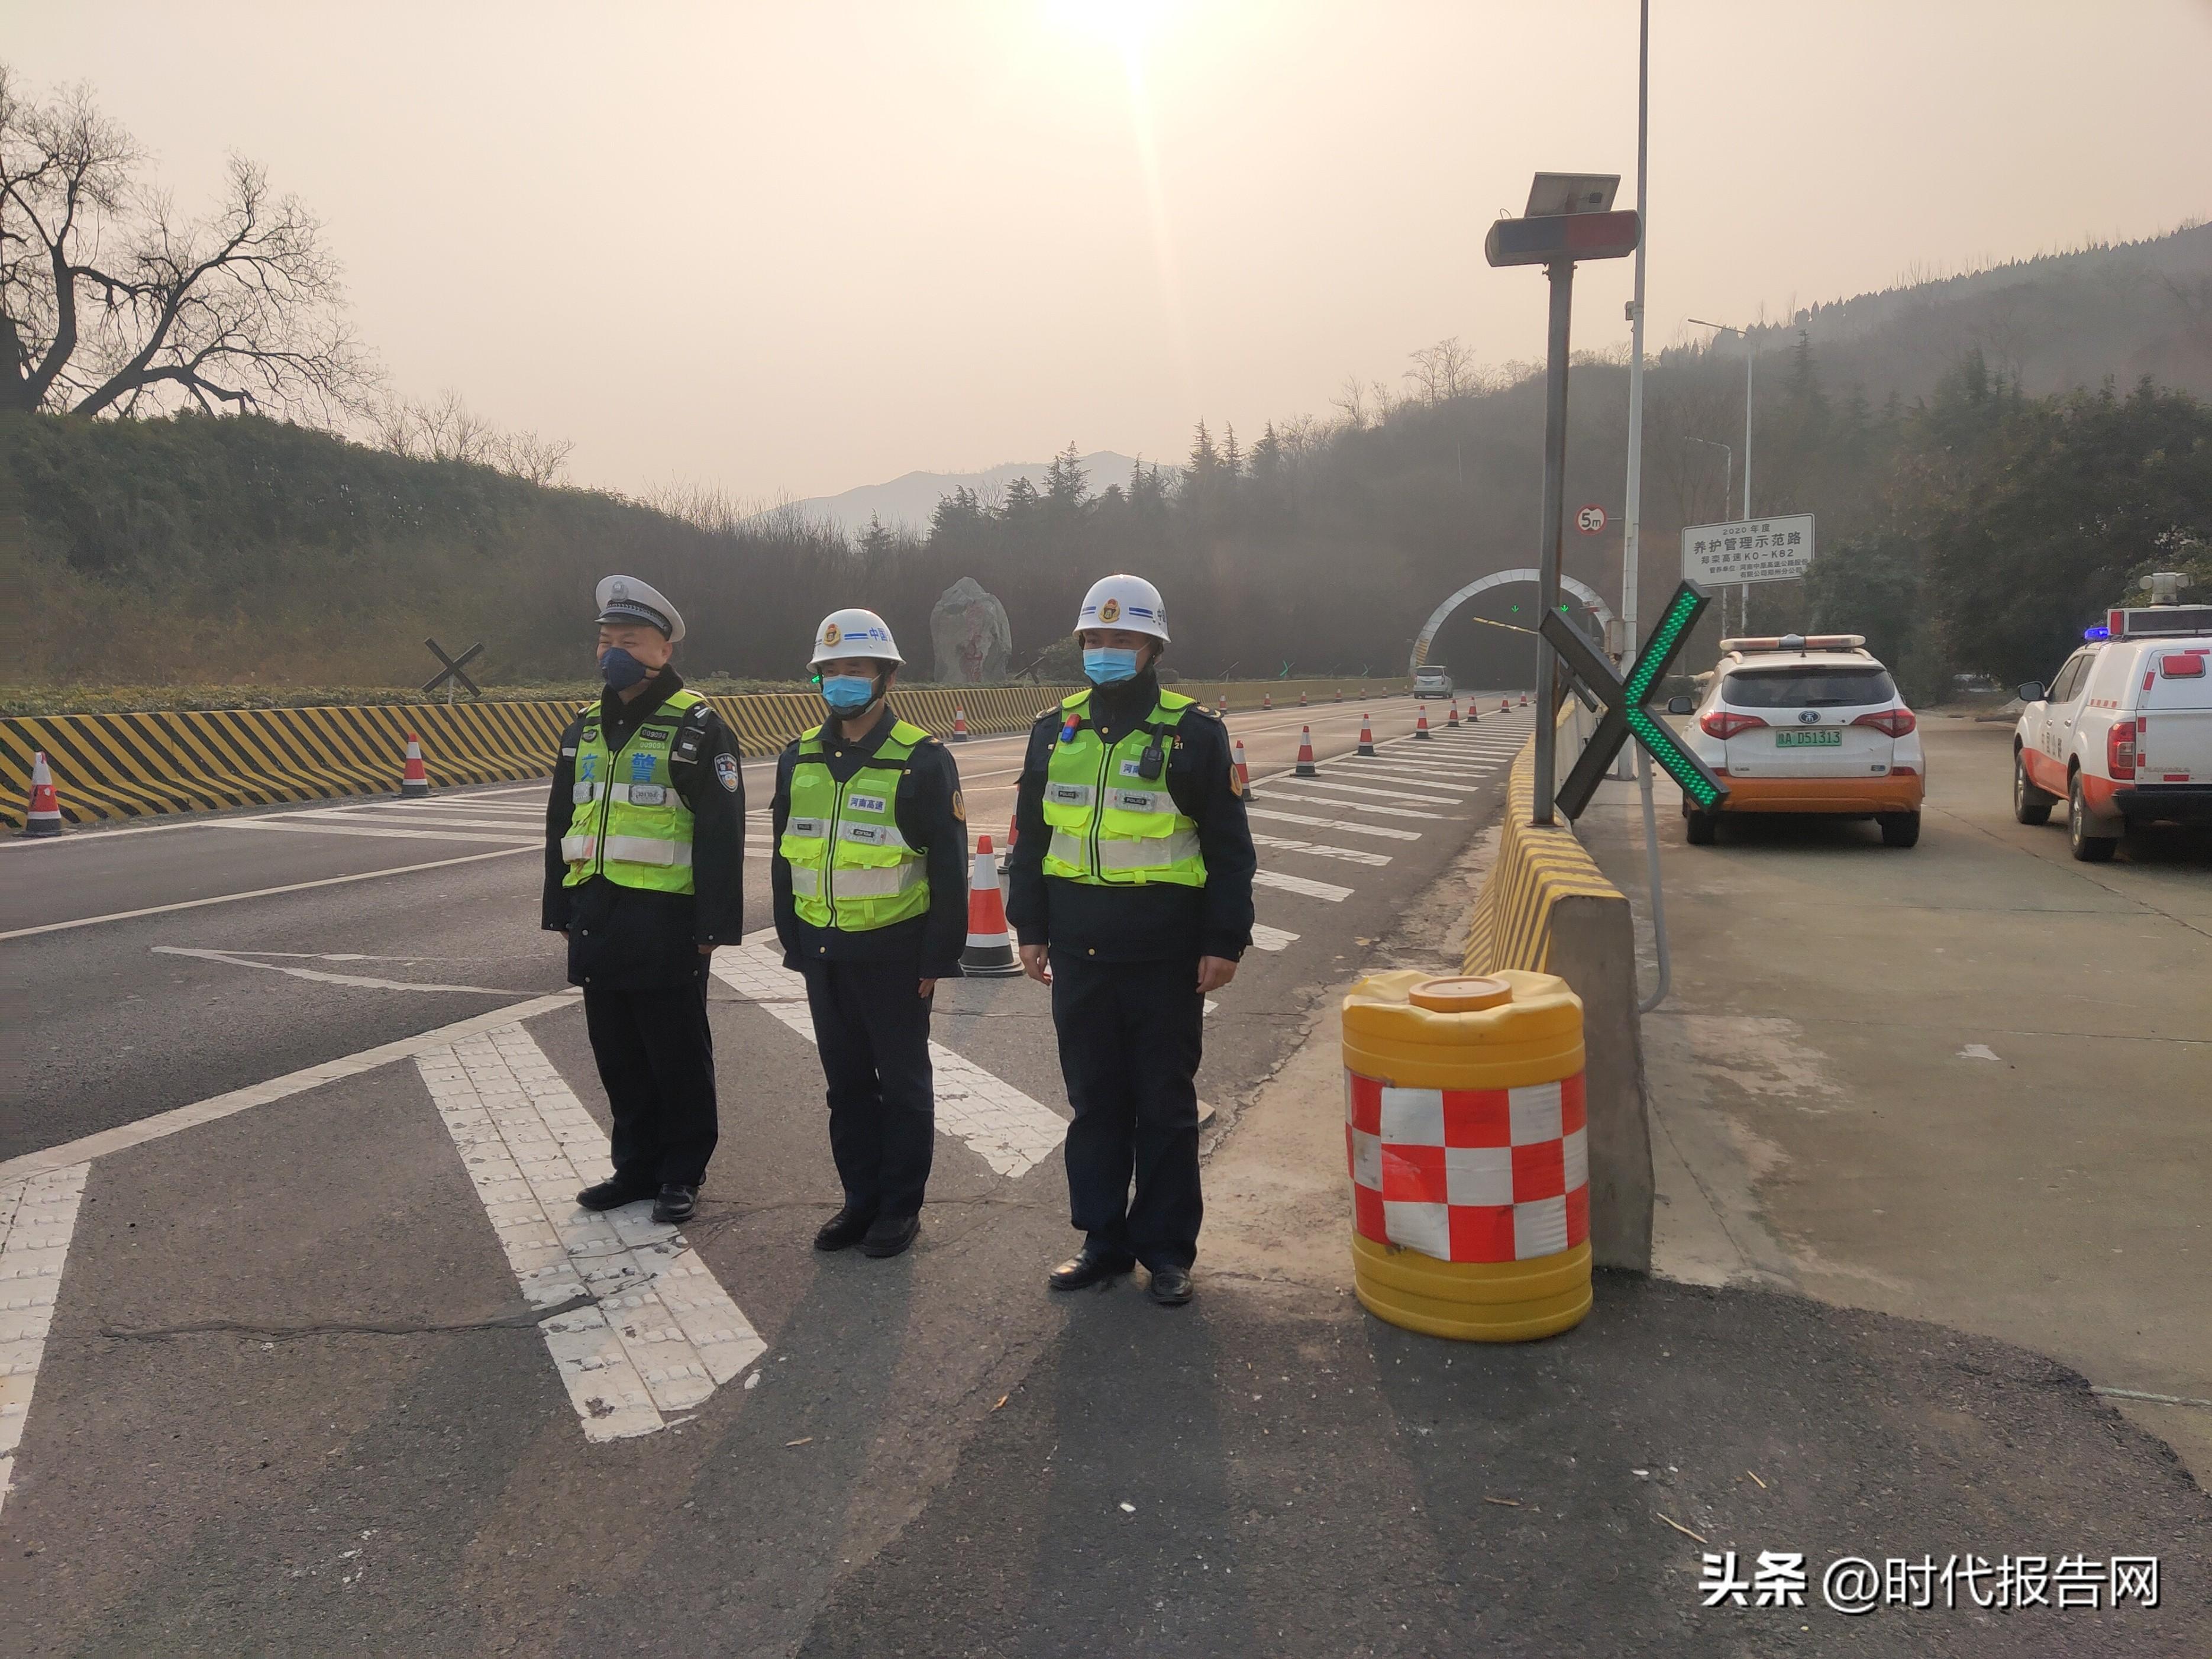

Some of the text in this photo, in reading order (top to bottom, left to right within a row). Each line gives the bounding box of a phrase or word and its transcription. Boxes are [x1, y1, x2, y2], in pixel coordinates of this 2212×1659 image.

[1582, 512, 1601, 527] 5m
[1694, 531, 1801, 554] 养护管理示范路
[869, 627, 892, 642] 中国
[851, 798, 884, 811] 河南高速
